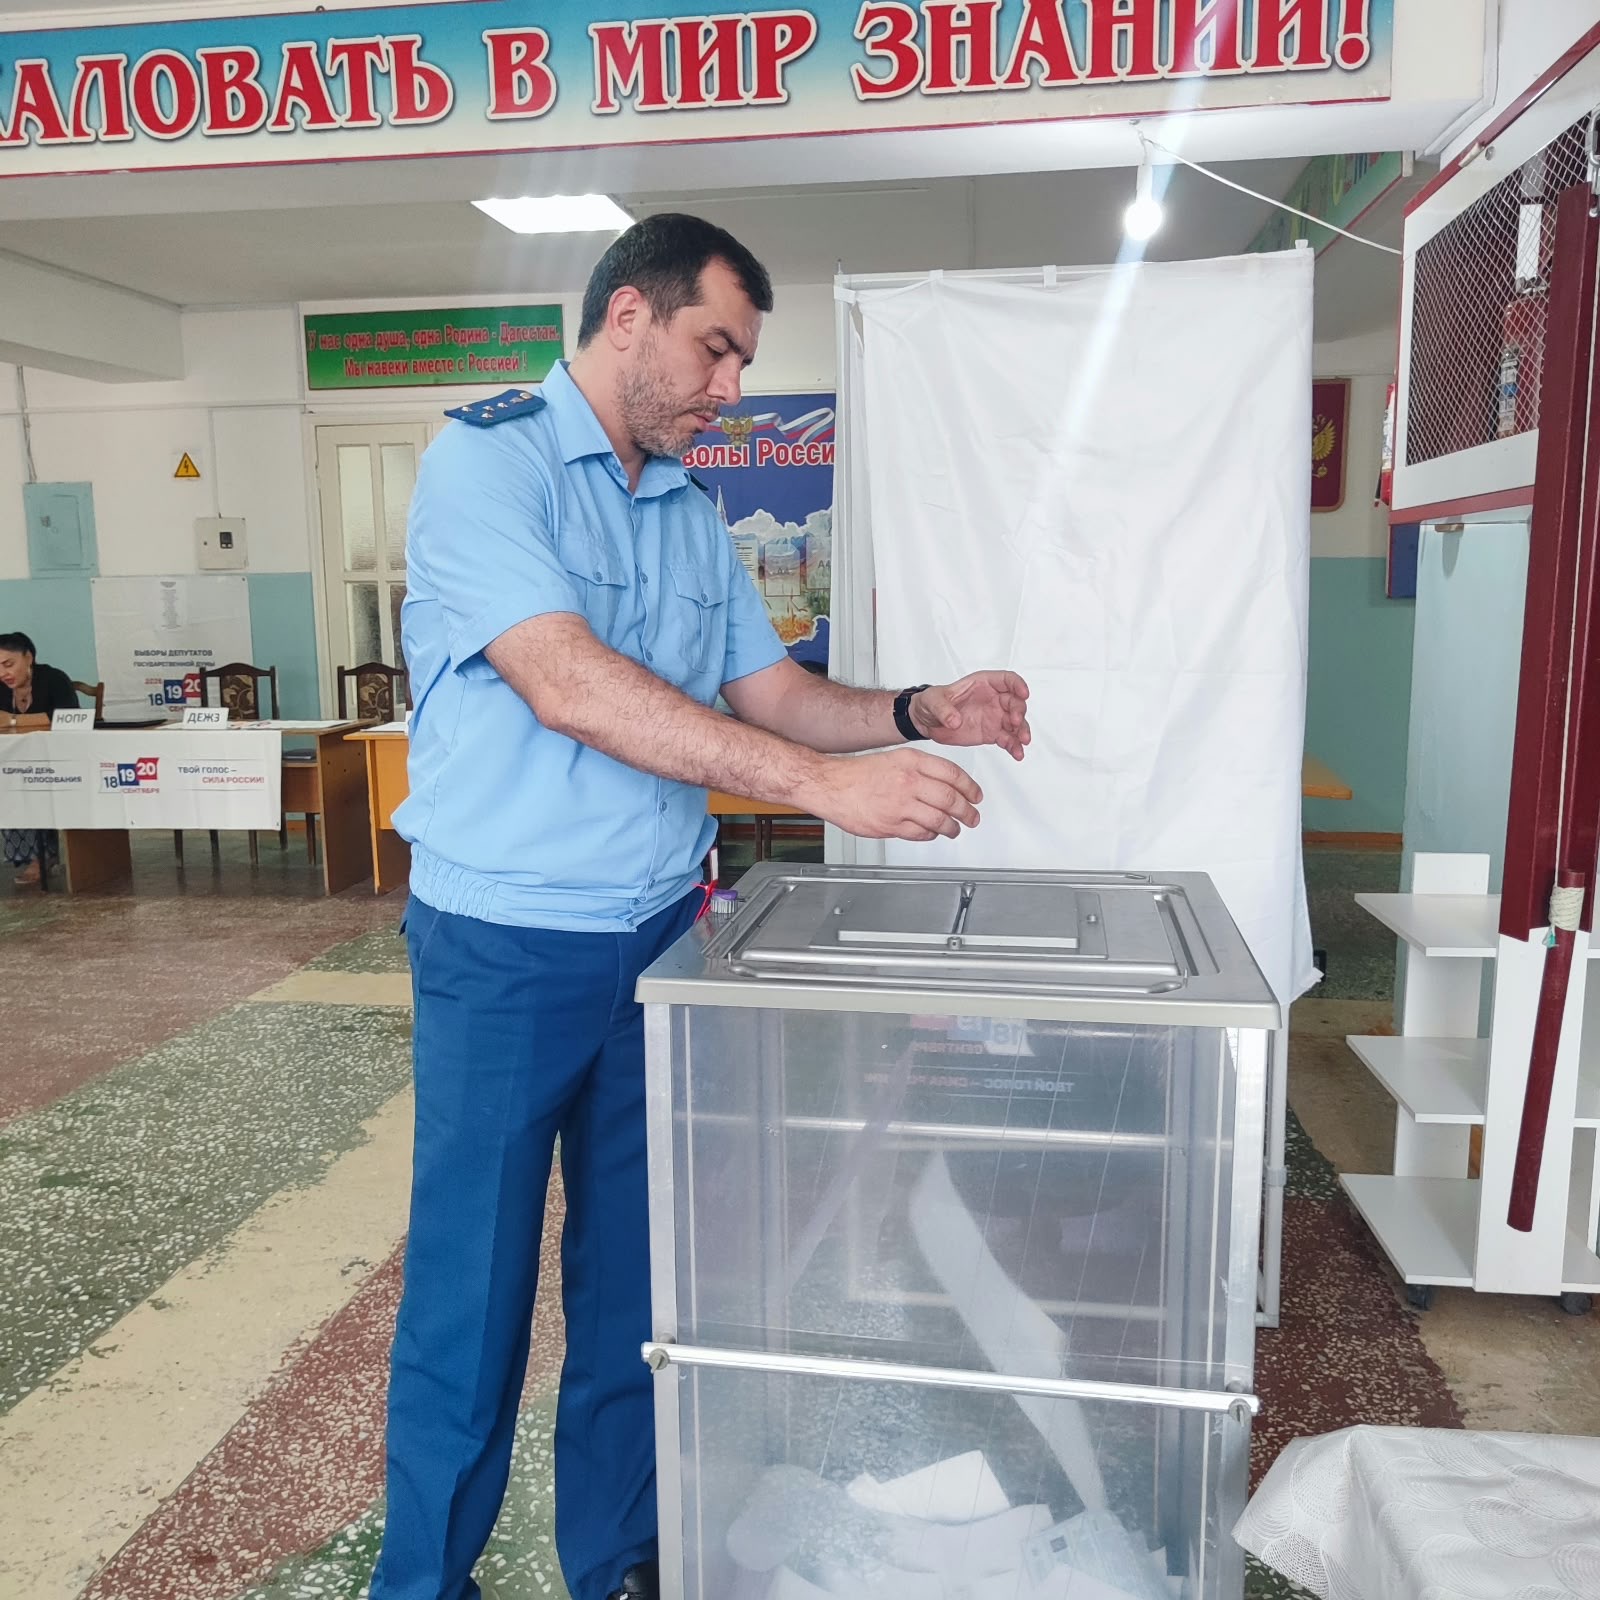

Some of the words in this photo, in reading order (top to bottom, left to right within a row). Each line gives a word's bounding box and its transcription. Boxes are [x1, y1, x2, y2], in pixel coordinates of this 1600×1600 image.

[0, 36, 453, 146] АЛОВАТЬ
[485, 27, 556, 119] В
[590, 9, 817, 114] МИР
[320, 334, 341, 350] нас
[344, 333, 373, 352] одна
[375, 330, 411, 352] душа,
[412, 328, 442, 350] одна
[444, 323, 490, 347] Родина
[344, 357, 365, 377] Мы
[367, 360, 410, 376] навеки
[412, 358, 454, 374] вместе
[457, 357, 465, 373] с
[467, 350, 519, 373] Россией
[134, 649, 167, 657] ВЫБОРЫ
[168, 649, 213, 657] ДЕПУТАТОВ
[148, 692, 164, 706] 18
[165, 685, 183, 700] 19
[56, 713, 88, 723] НОПР
[187, 712, 220, 724] ДЕЖЗ
[103, 776, 118, 788] 18
[119, 768, 136, 783] 19
[136, 762, 156, 776] 20
[178, 765, 201, 774] ТВОЙ
[201, 766, 230, 774] ГОЛОС
[202, 776, 225, 784] СИЛА
[226, 776, 264, 784] РОССИИ!
